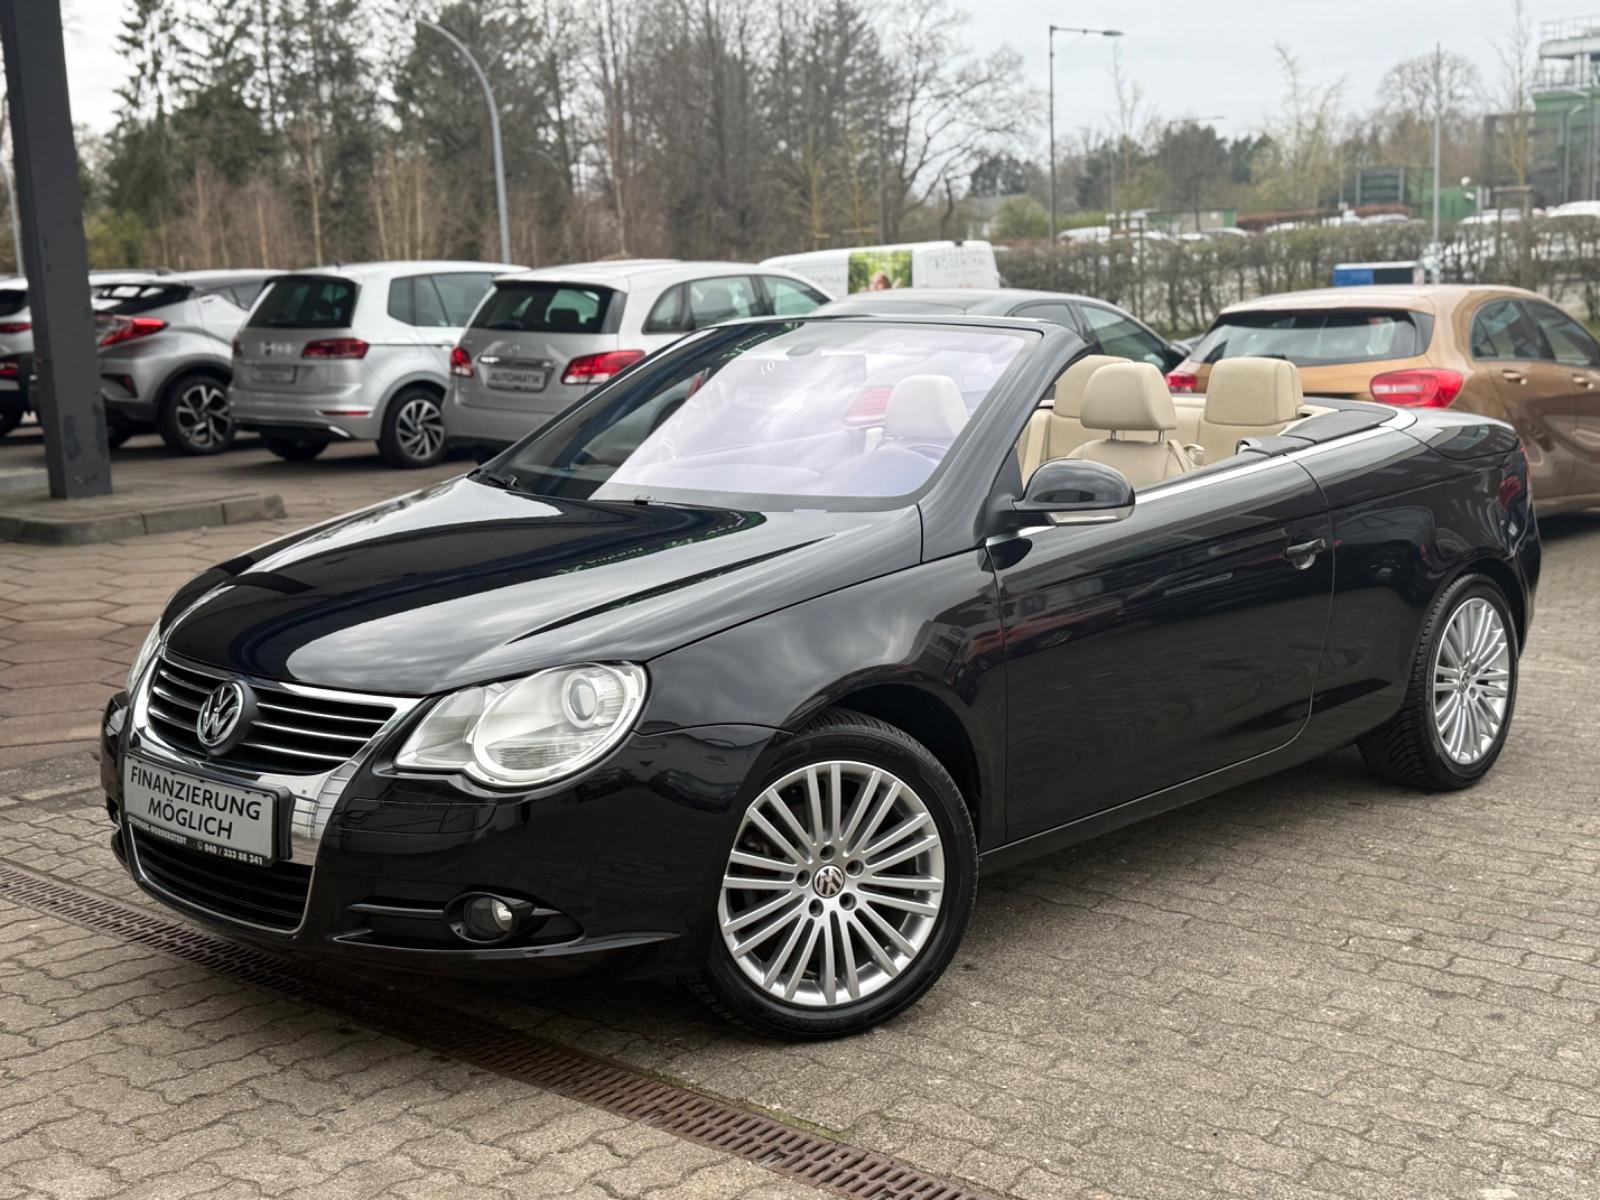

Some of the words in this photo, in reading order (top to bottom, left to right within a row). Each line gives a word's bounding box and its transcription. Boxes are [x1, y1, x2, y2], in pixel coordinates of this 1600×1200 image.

[490, 371, 540, 384] AUTOMATIK
[198, 683, 243, 746] VW
[130, 765, 262, 820] FINANZIERUNG
[148, 797, 233, 840] MÖGLICH
[223, 848, 237, 859] 333
[249, 854, 263, 865] 341
